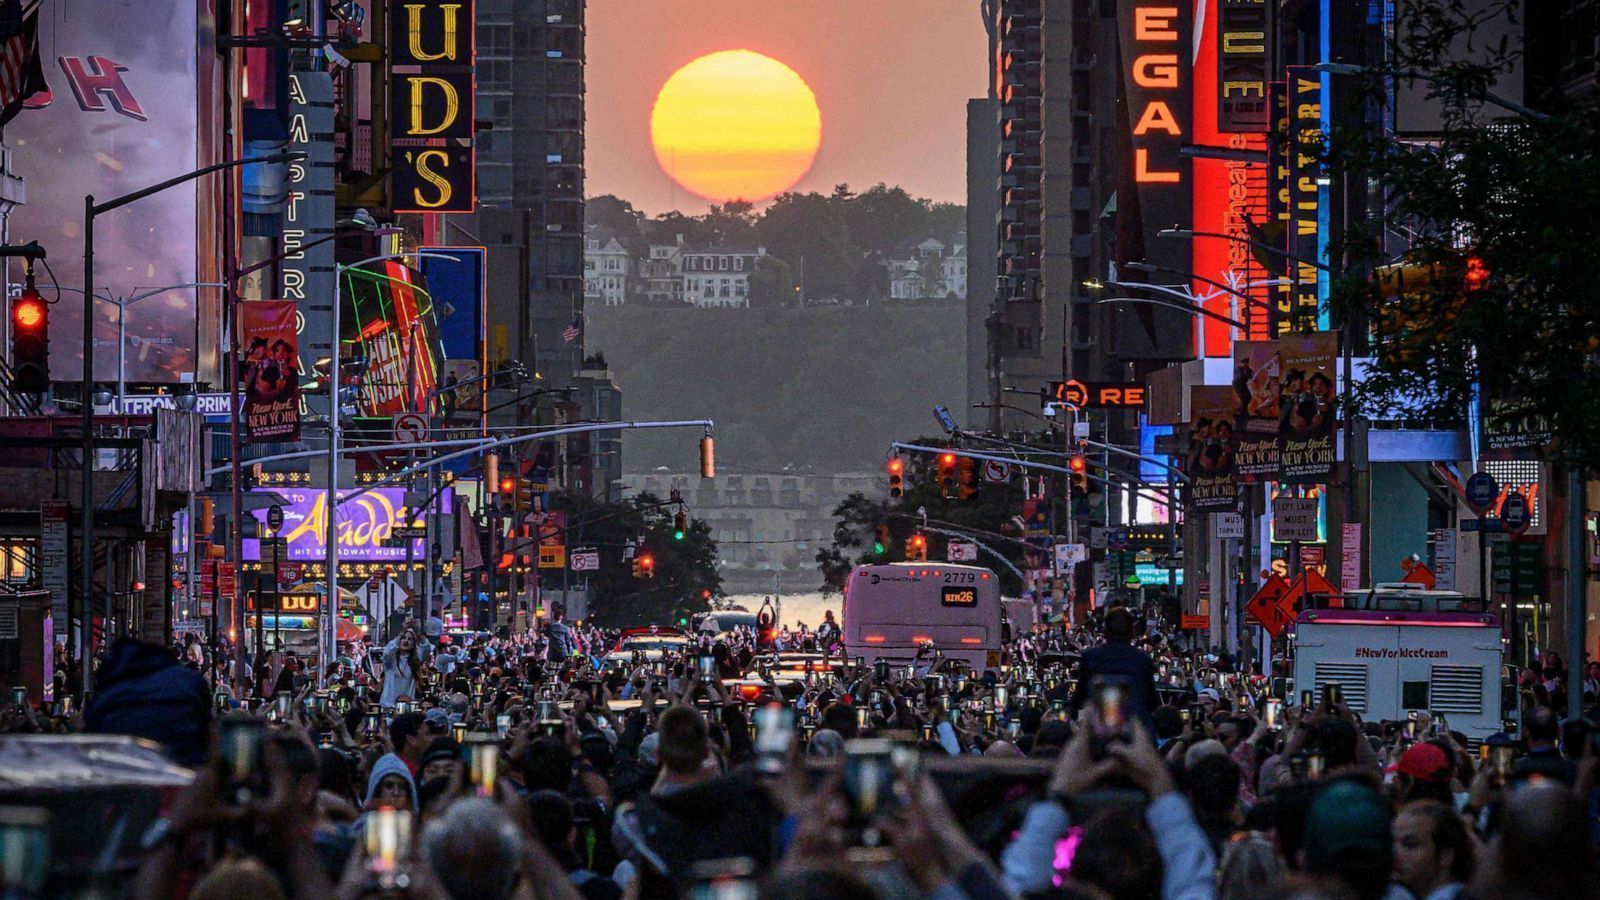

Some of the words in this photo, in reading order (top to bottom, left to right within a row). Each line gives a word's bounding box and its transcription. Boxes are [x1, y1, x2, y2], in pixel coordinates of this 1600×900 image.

[1132, 7, 1181, 182] EGAL
[197, 396, 231, 412] PRIM
[1100, 388, 1144, 404] RE
[248, 413, 268, 427] NEW
[269, 410, 297, 425] YORK
[1281, 452, 1303, 466] NEW
[1304, 449, 1335, 464] YORK
[1284, 515, 1307, 524] MUST
[375, 548, 420, 556] MUSICL
[944, 572, 975, 583] 2779
[1355, 647, 1448, 659] #NewYorkIceCream
